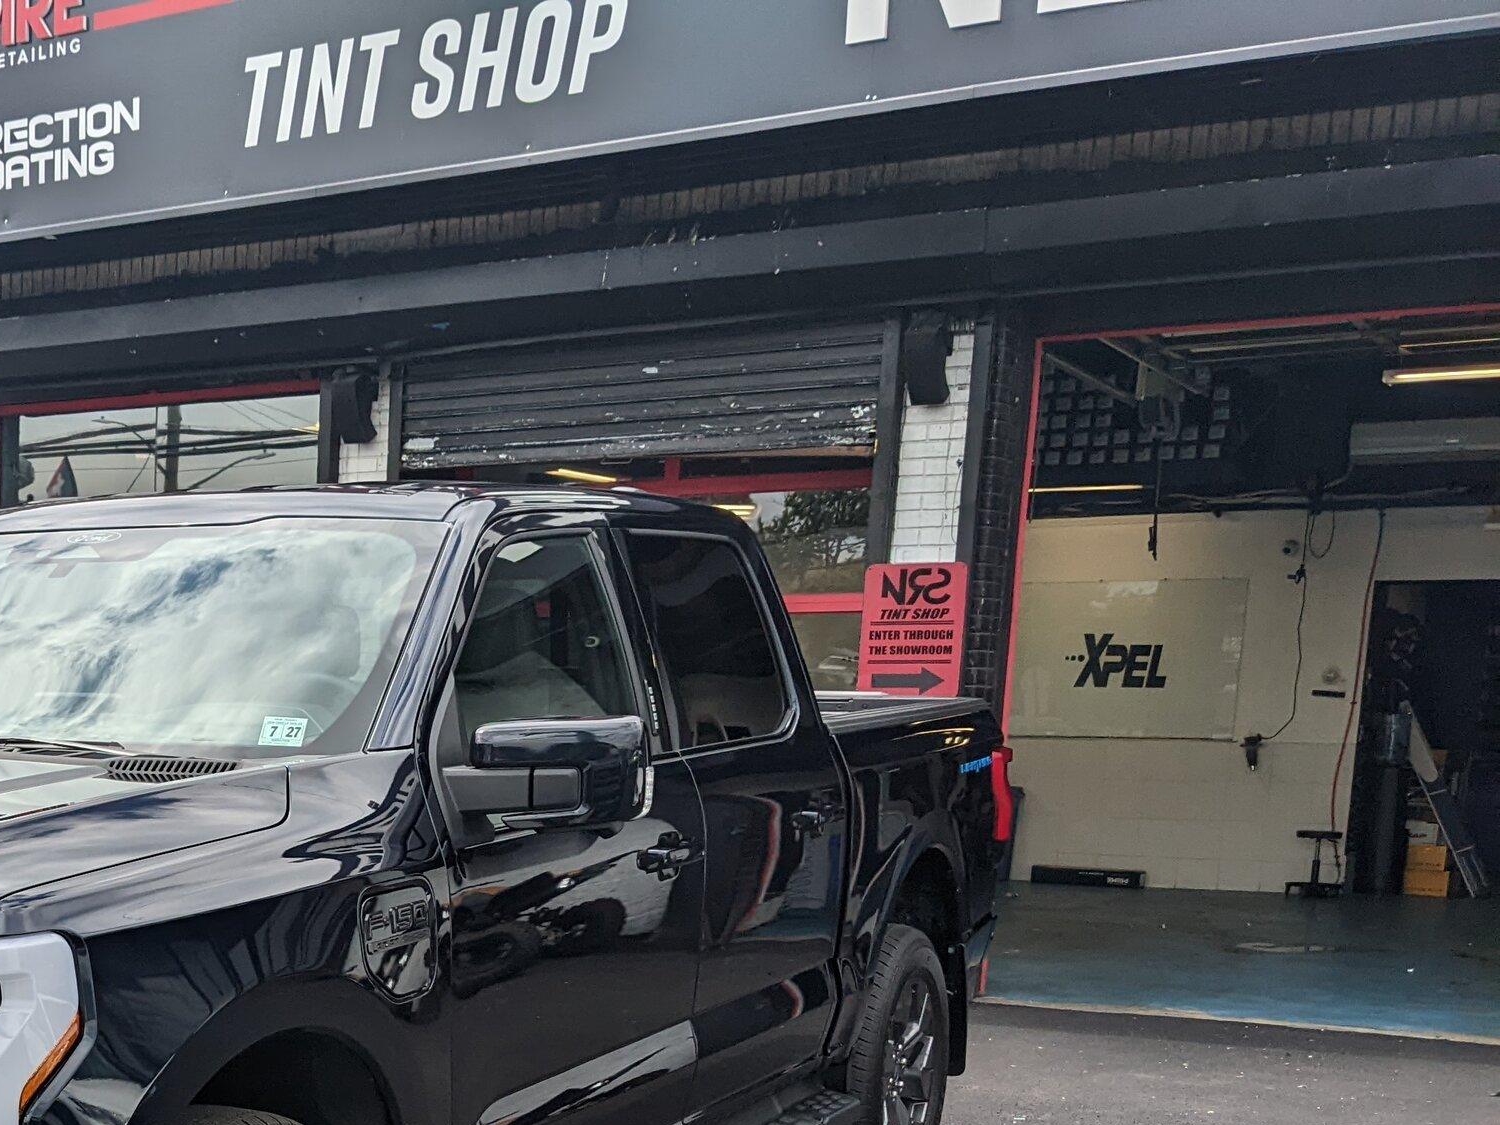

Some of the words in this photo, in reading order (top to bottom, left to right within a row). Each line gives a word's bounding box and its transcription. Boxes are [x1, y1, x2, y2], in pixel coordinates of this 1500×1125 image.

[244, 29, 400, 148] TINT
[410, 0, 629, 119] SHOP
[880, 608, 911, 620] TINT
[911, 608, 950, 619] SHOP
[868, 630, 900, 640] ENTER
[903, 629, 954, 640] THROUGH
[868, 645, 887, 655] THE
[889, 645, 953, 655] SHOWROOM
[1073, 633, 1167, 688] XPEL
[269, 726, 278, 738] 7
[285, 726, 302, 738] 27
